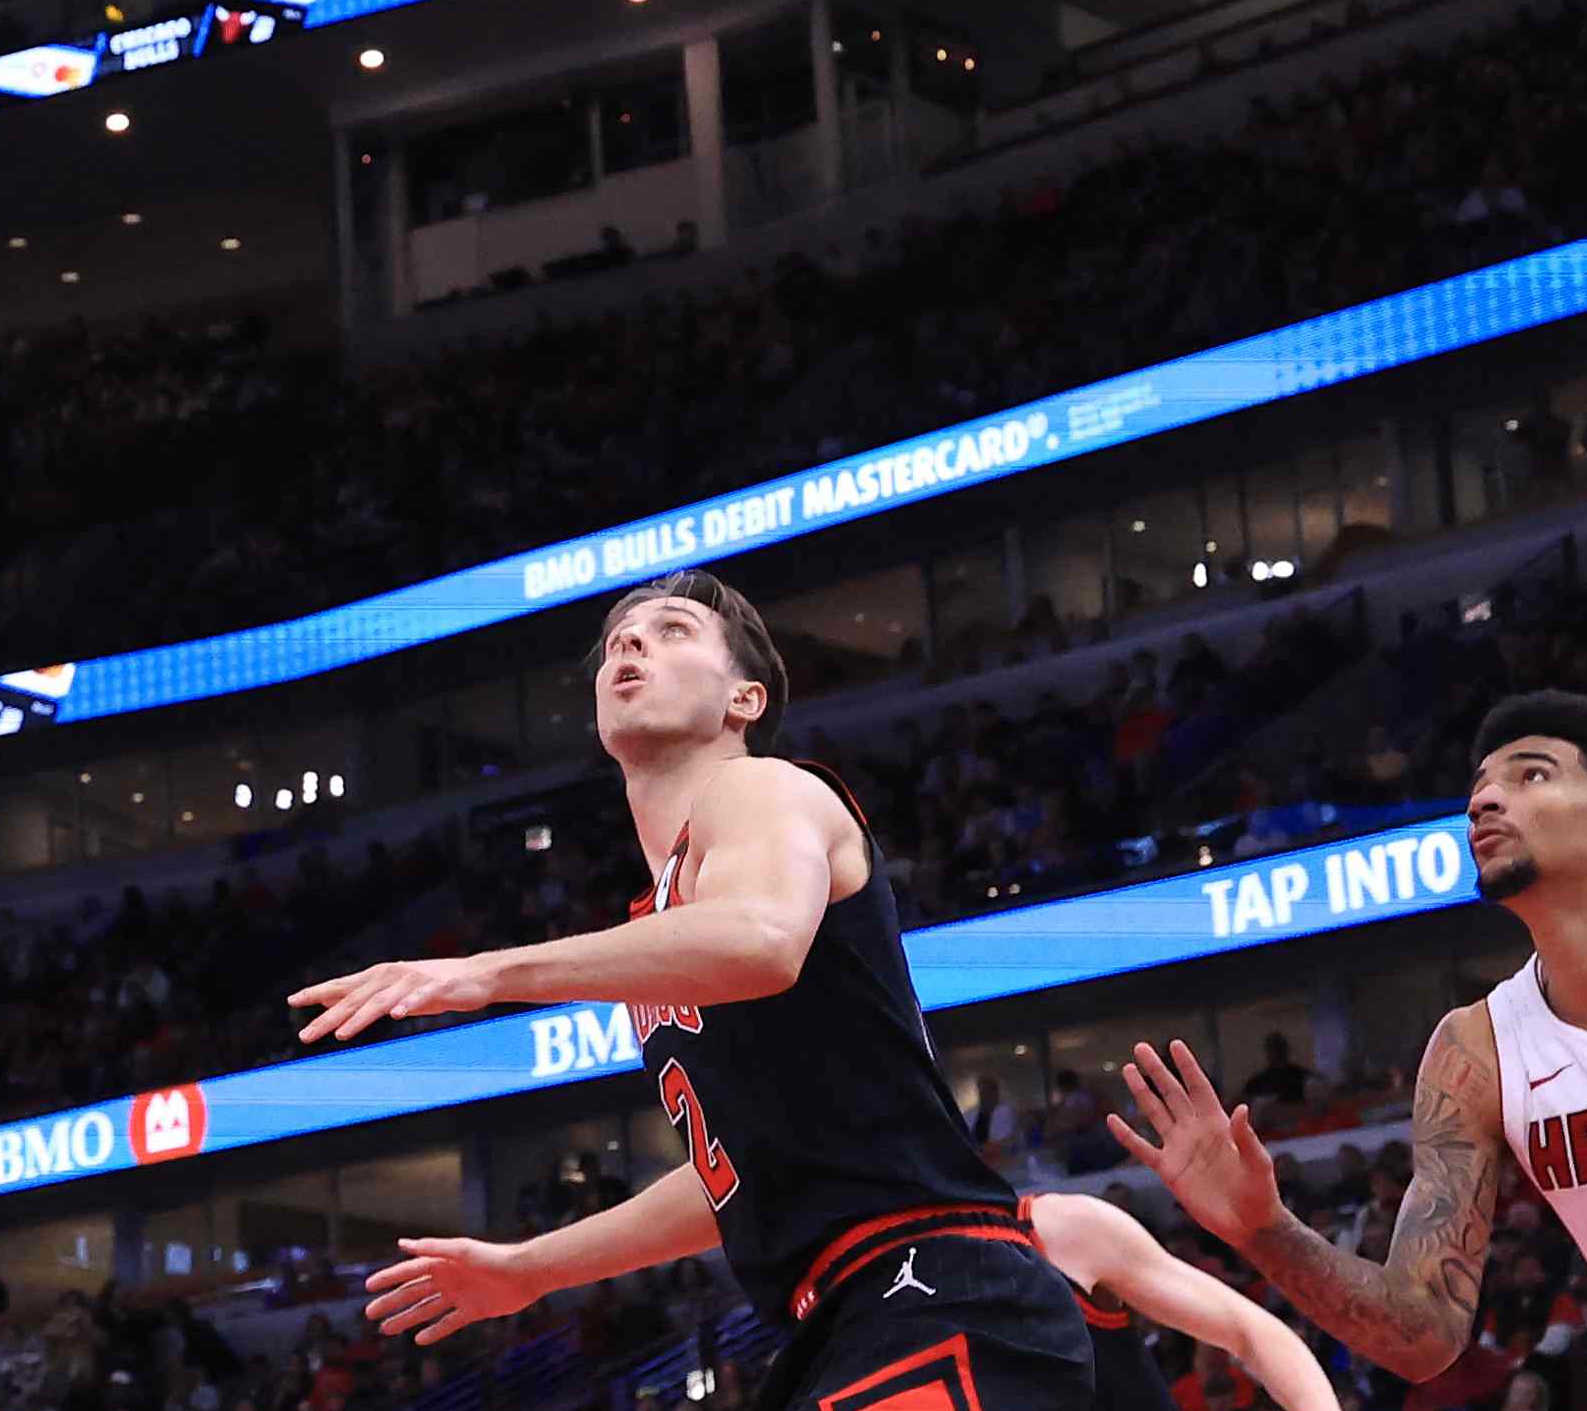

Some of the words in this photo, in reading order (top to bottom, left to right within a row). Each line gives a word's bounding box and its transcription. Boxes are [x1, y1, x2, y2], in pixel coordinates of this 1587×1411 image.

[525, 548, 598, 600] BMO
[603, 518, 699, 578] BULLS
[704, 487, 796, 549] DEBIT
[1203, 865, 1311, 938] TAP
[1326, 832, 1462, 916] INTO
[658, 1058, 740, 1211] 2
